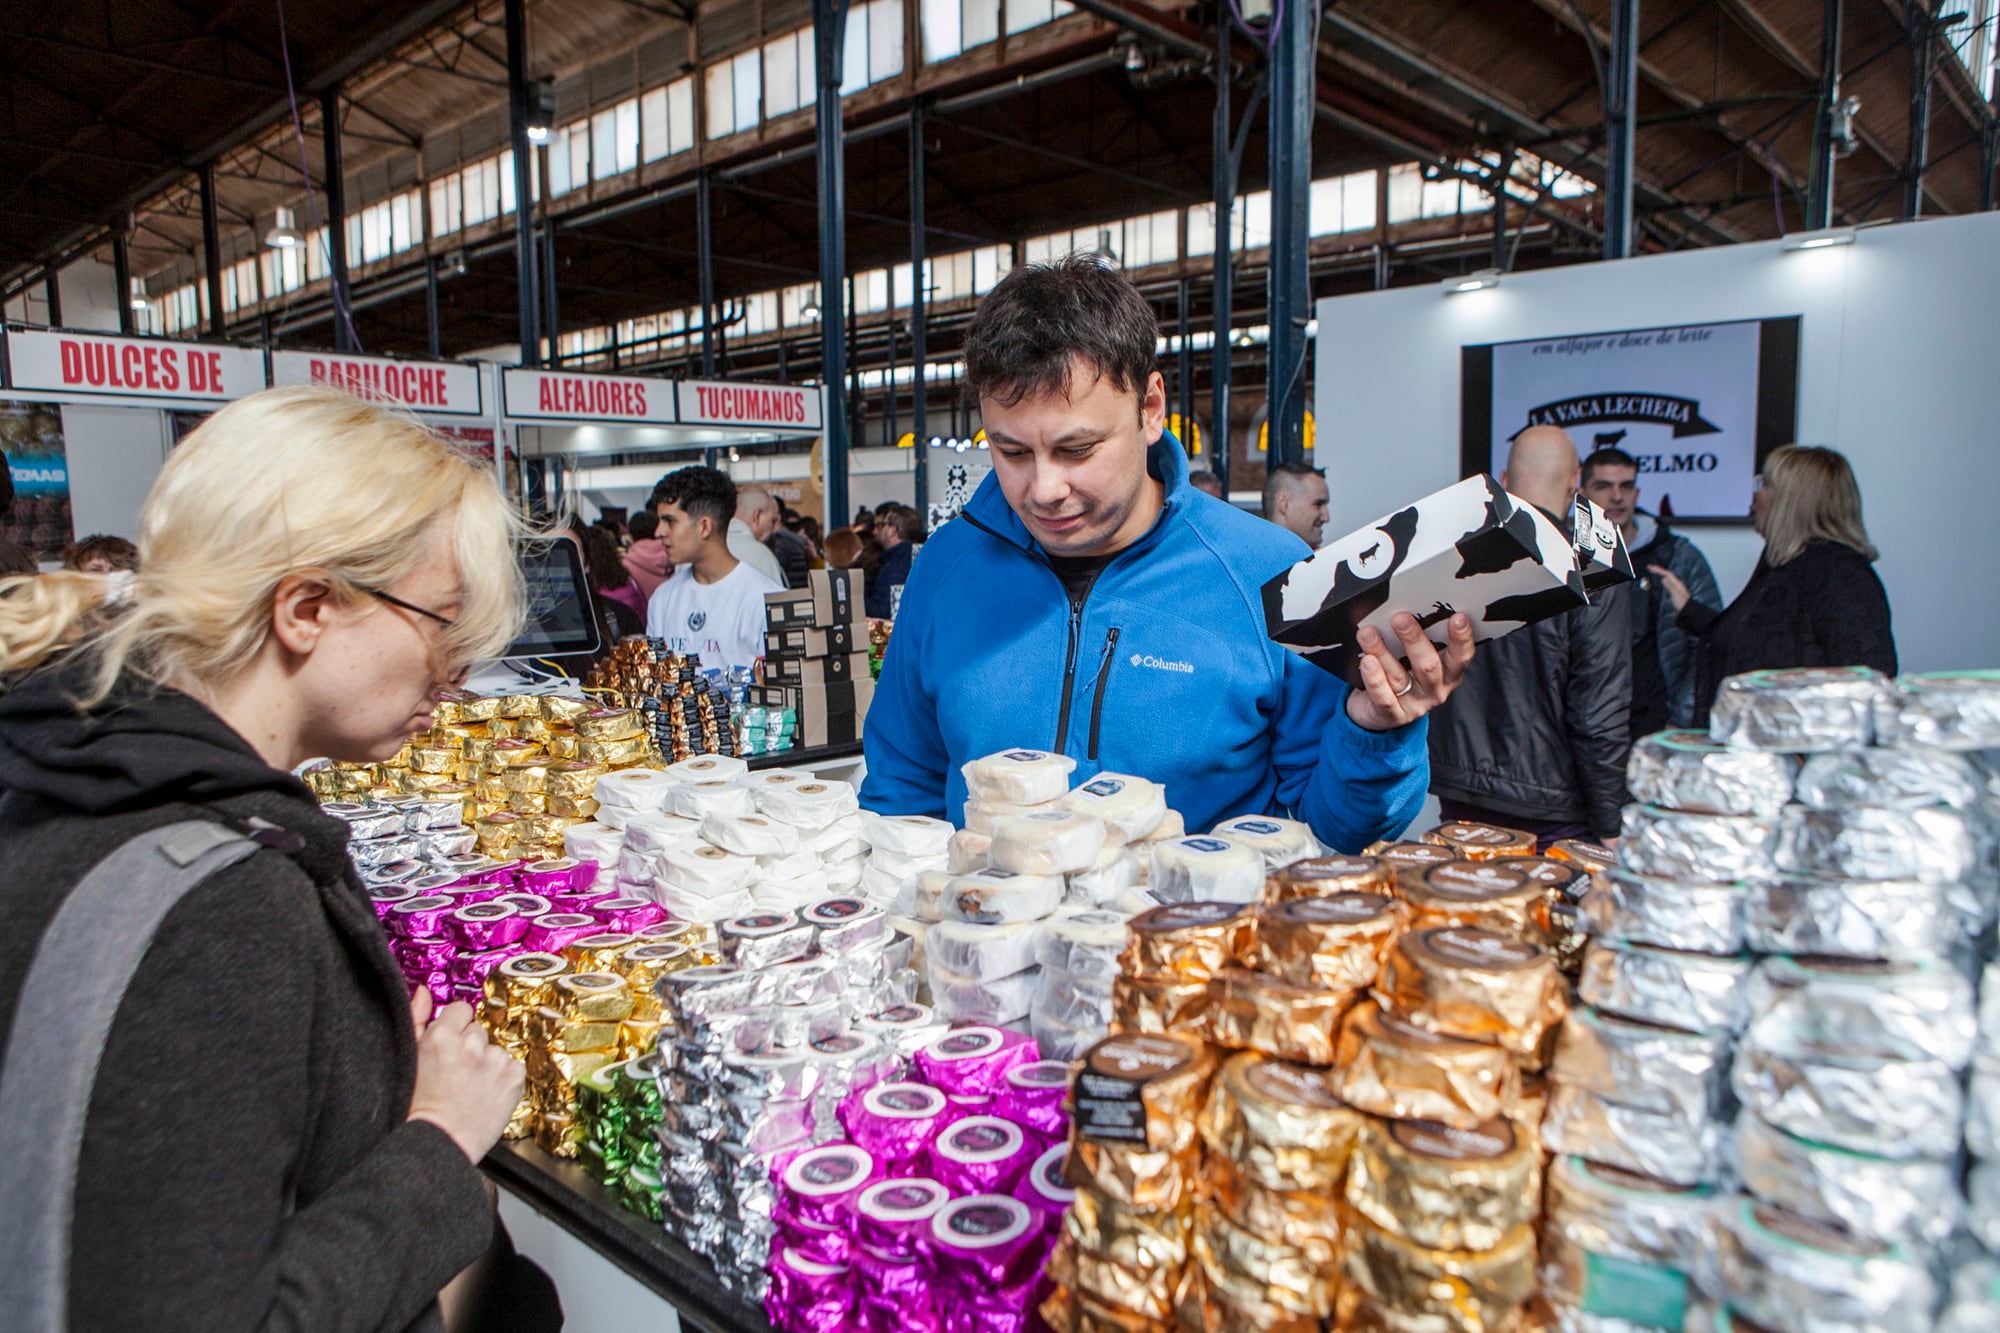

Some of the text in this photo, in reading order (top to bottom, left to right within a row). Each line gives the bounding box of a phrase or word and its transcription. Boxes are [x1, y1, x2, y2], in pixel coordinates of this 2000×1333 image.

[60, 339, 224, 394] DULCES DE
[310, 359, 449, 406] BARILOCHE
[538, 376, 806, 423] ALFAJORES TUCUMANOS
[1530, 397, 1690, 426] LA VACA LECHERA
[1633, 453, 1718, 474] ELMO
[1143, 655, 1194, 673] Columbia
